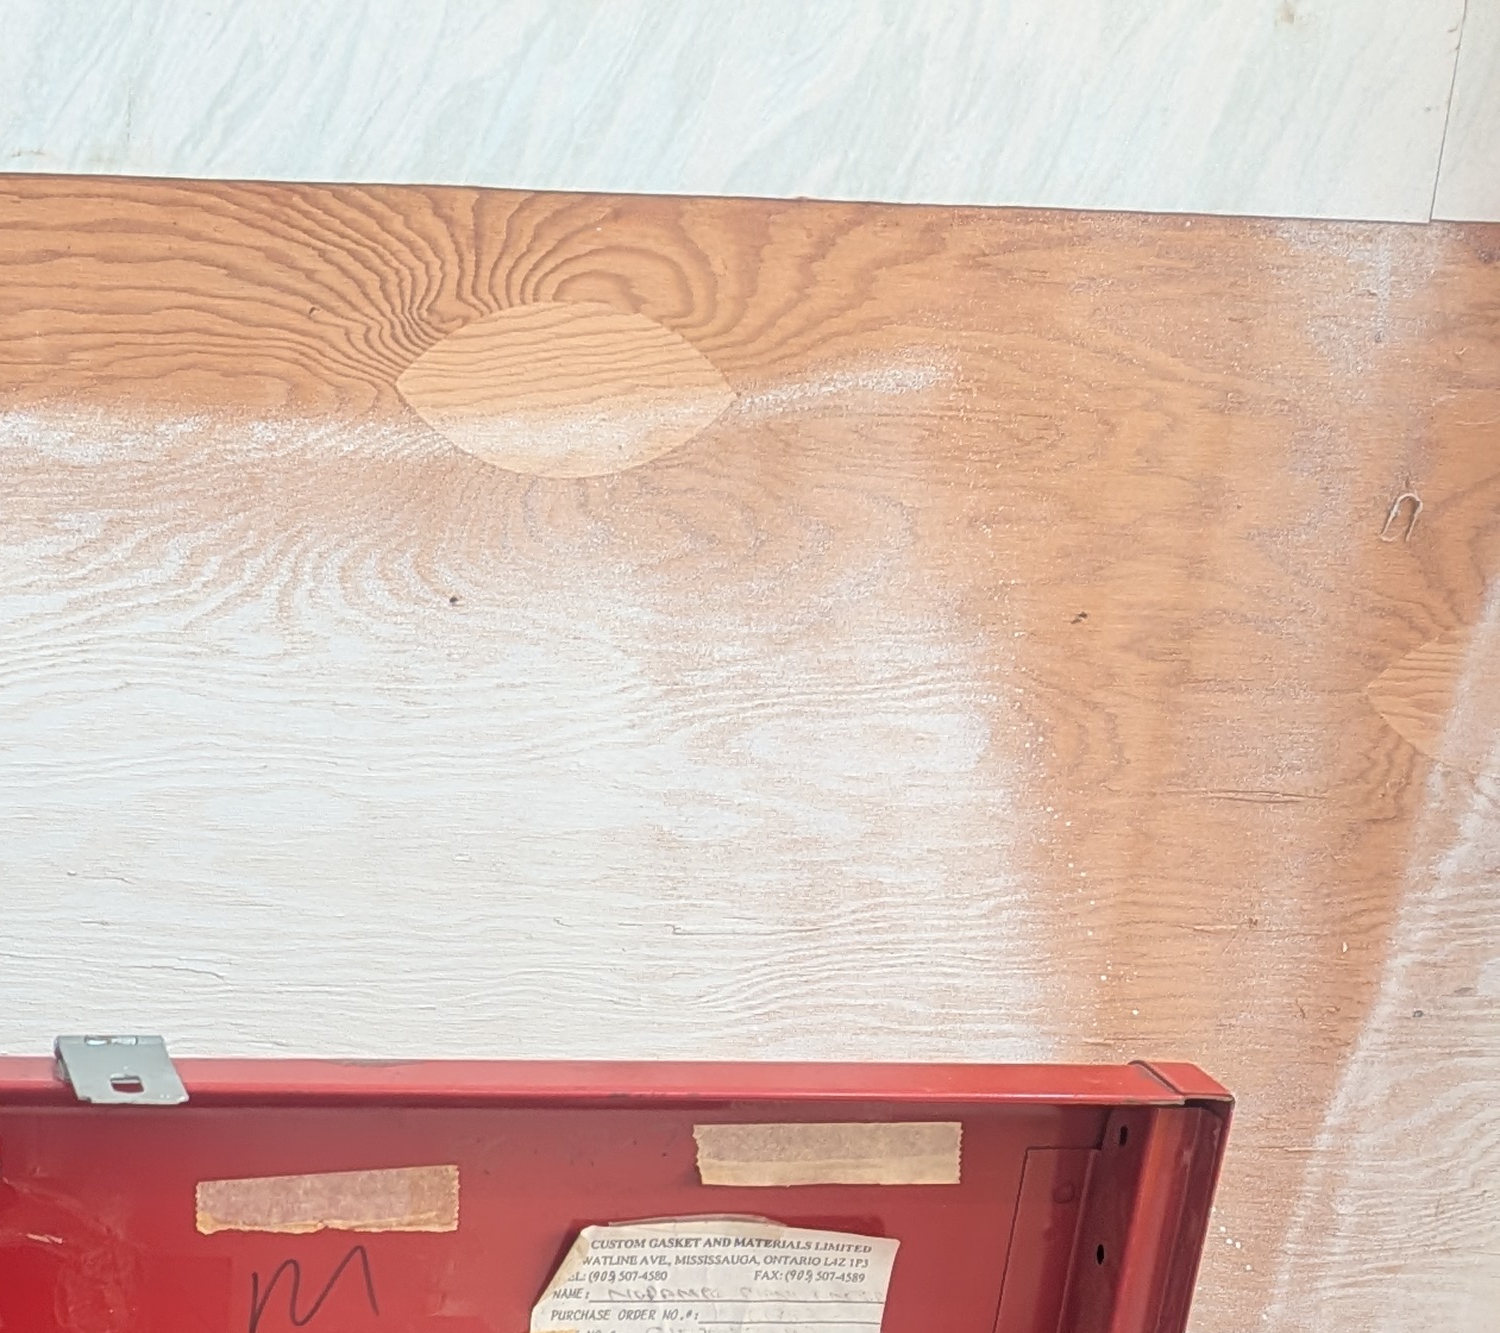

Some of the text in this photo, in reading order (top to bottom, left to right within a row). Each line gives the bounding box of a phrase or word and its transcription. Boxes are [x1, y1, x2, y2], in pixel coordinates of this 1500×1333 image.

[590, 1237, 873, 1254] CUSTOM GASKET AND MATERIALS LIMITED
[674, 1254, 760, 1267] MISSISSAUGA,
[763, 1254, 822, 1267] ONTARIO
[823, 1256, 847, 1268] L4Z
[849, 1257, 870, 1269] 1P3
[618, 1271, 668, 1282] 507-4580
[753, 1270, 784, 1281] FAX:
[815, 1271, 866, 1283] 507-4589
[552, 1287, 591, 1300] NAME:
[550, 1309, 611, 1321] PURCHASE
[617, 1309, 656, 1321] ORDER
